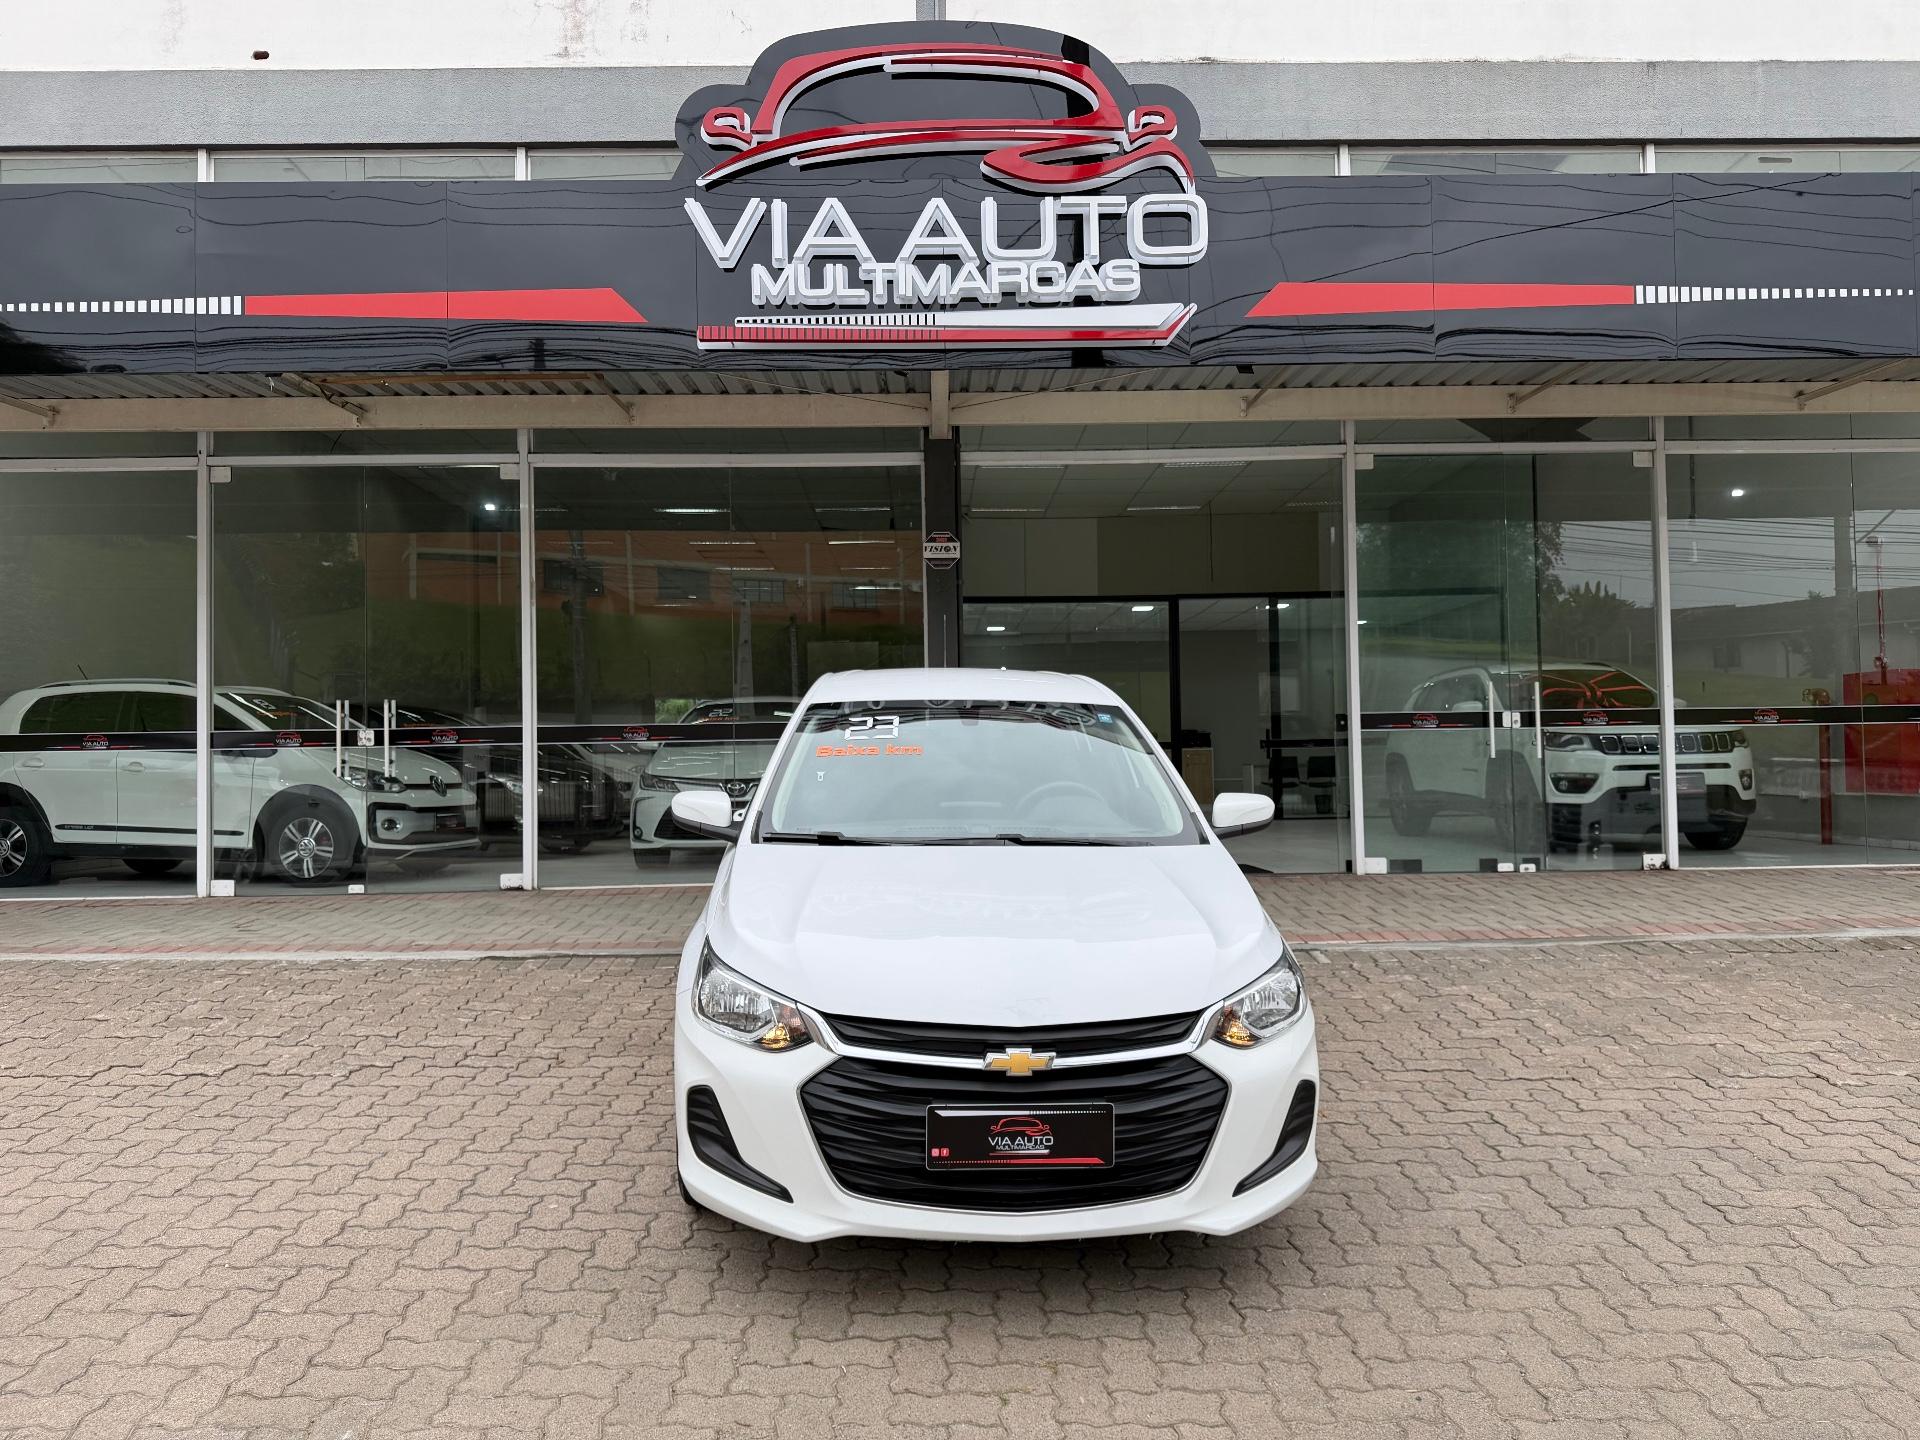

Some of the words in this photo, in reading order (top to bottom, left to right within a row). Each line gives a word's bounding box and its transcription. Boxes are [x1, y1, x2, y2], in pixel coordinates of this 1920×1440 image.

[684, 197, 874, 268] VIA
[897, 194, 1208, 267] AUTO
[751, 258, 1140, 305] MULTIMARCAS
[845, 716, 899, 740] 23
[816, 744, 880, 757] Baixa
[885, 743, 924, 755] km
[988, 1136, 1011, 1146] VIA
[1014, 1135, 1054, 1146] AUTO
